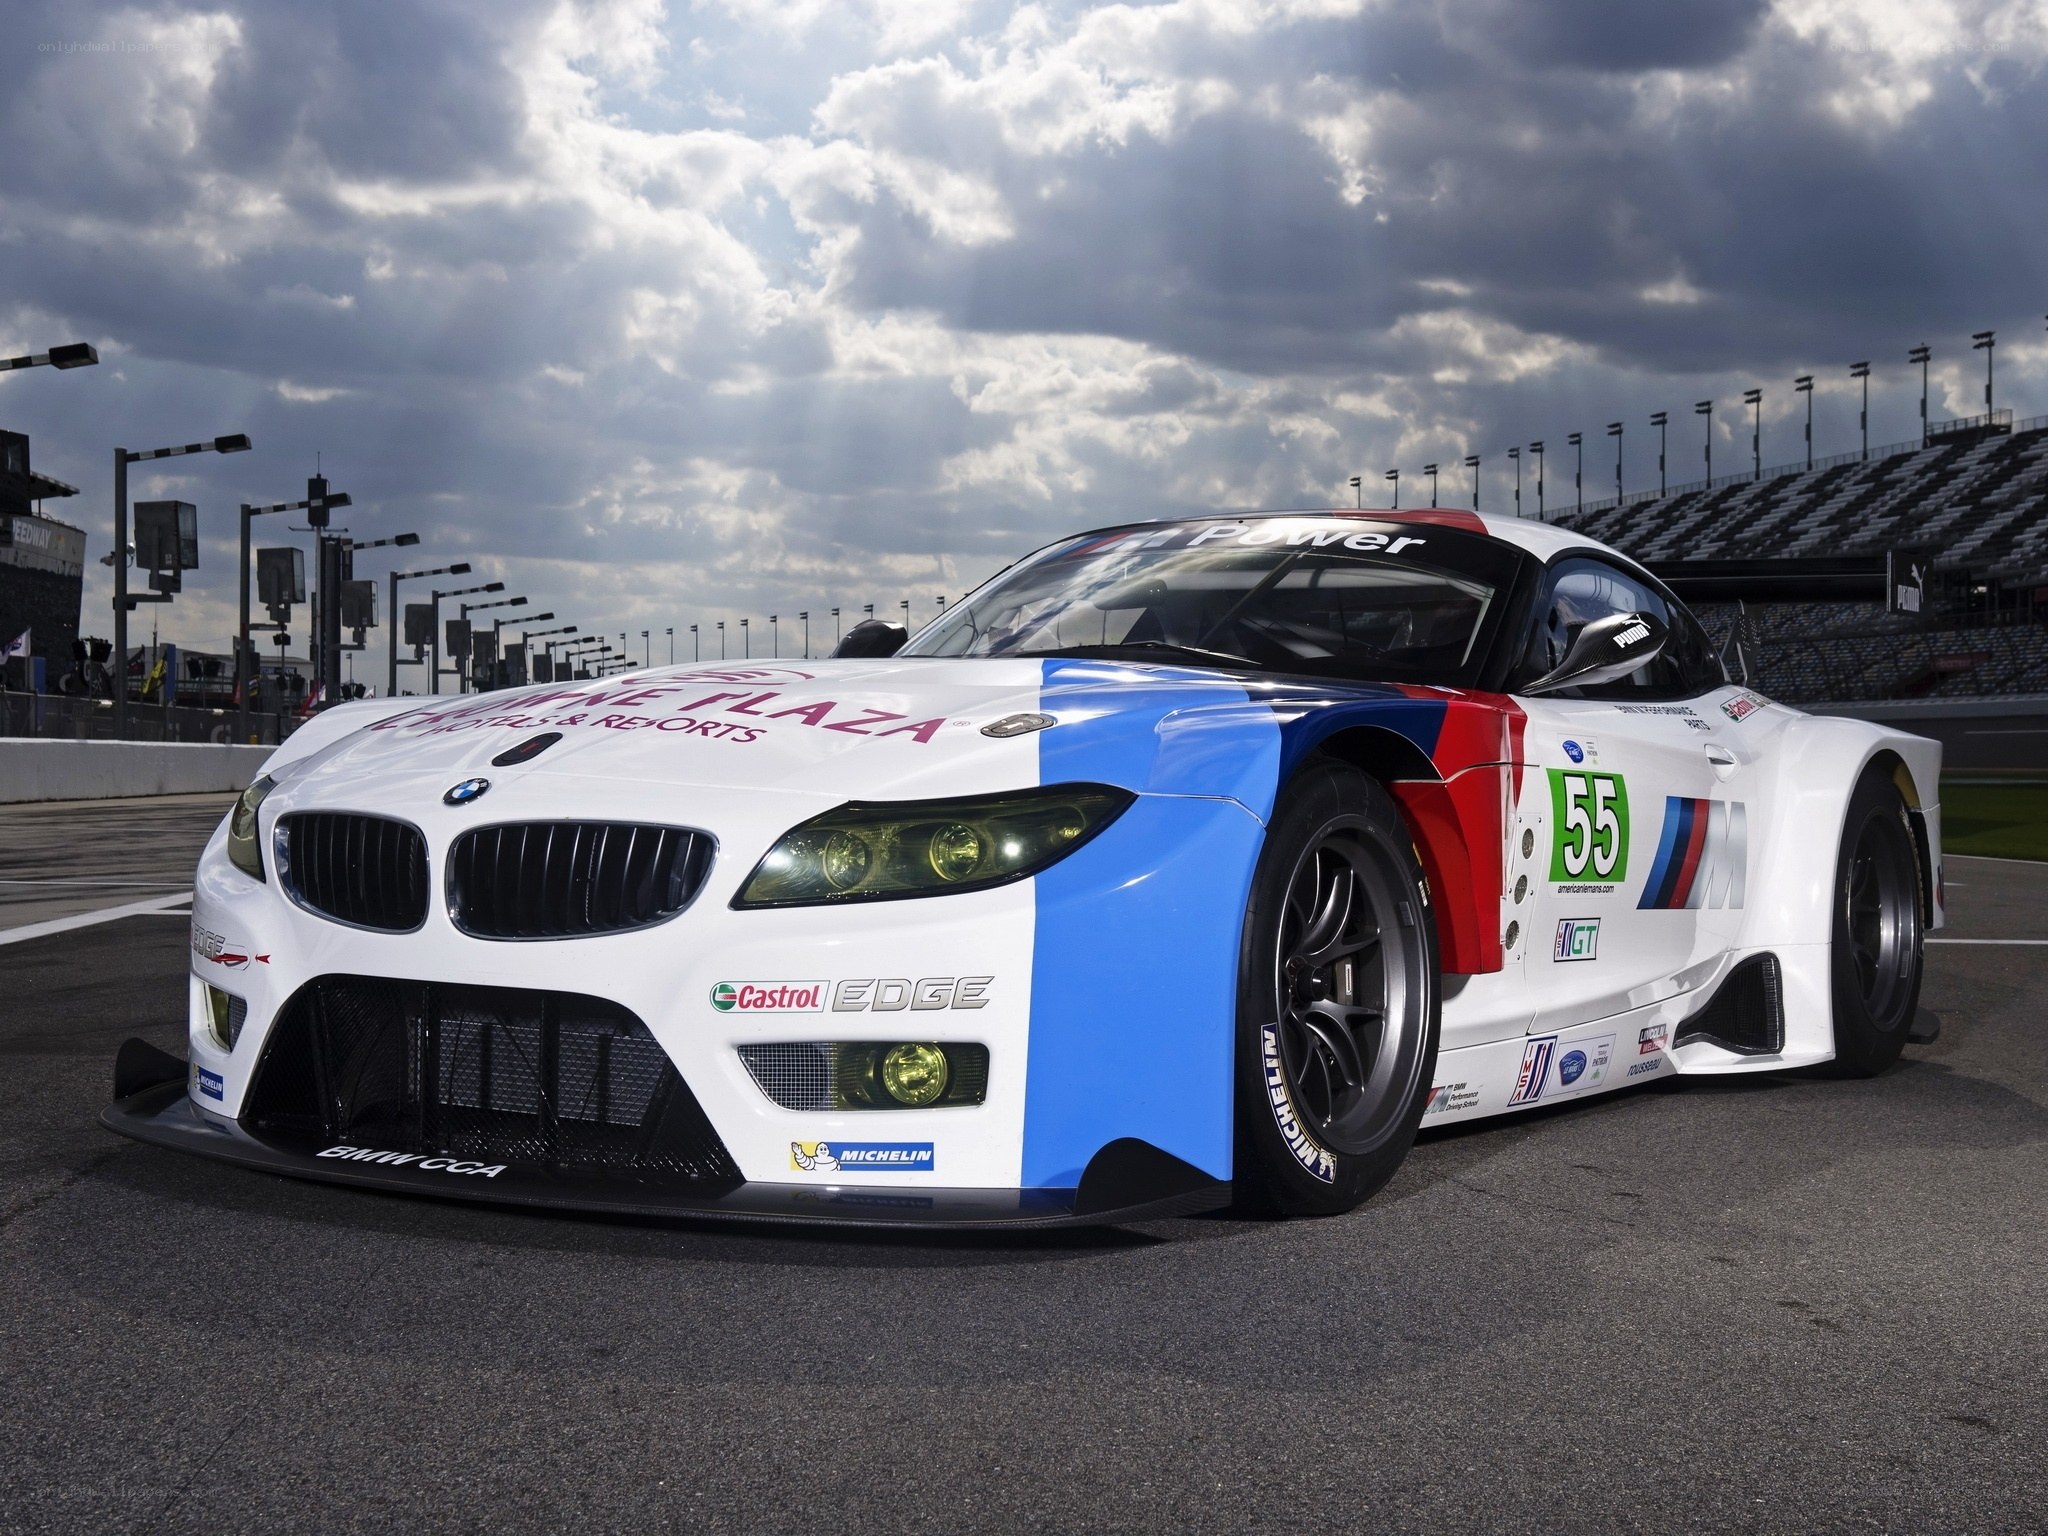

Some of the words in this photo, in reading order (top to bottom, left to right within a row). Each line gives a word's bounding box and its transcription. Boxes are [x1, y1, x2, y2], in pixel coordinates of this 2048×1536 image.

[1186, 525, 1427, 554] Power
[1897, 584, 1919, 612] PUMA
[1612, 624, 1650, 648] PUMA
[416, 713, 560, 737] HOTELS
[555, 713, 589, 726] &
[677, 692, 947, 744] PLAZA
[1563, 773, 1620, 878] 55
[1557, 883, 1615, 895] americanlemans.com
[1572, 925, 1597, 955] GT
[738, 985, 820, 1009] Castrol
[831, 976, 995, 1012] EDGE
[200, 1074, 223, 1092] MICHELIN
[1453, 1082, 1467, 1091] BMW
[1512, 1045, 1534, 1102] IMSA
[1263, 1029, 1319, 1168] MICHELIN
[1446, 1102, 1463, 1111] Driving
[1462, 1099, 1480, 1109] School
[1450, 1091, 1479, 1102] Performance
[316, 1145, 428, 1165] BMW
[418, 1158, 508, 1178] CCA
[840, 1150, 933, 1162] MICHELIN
